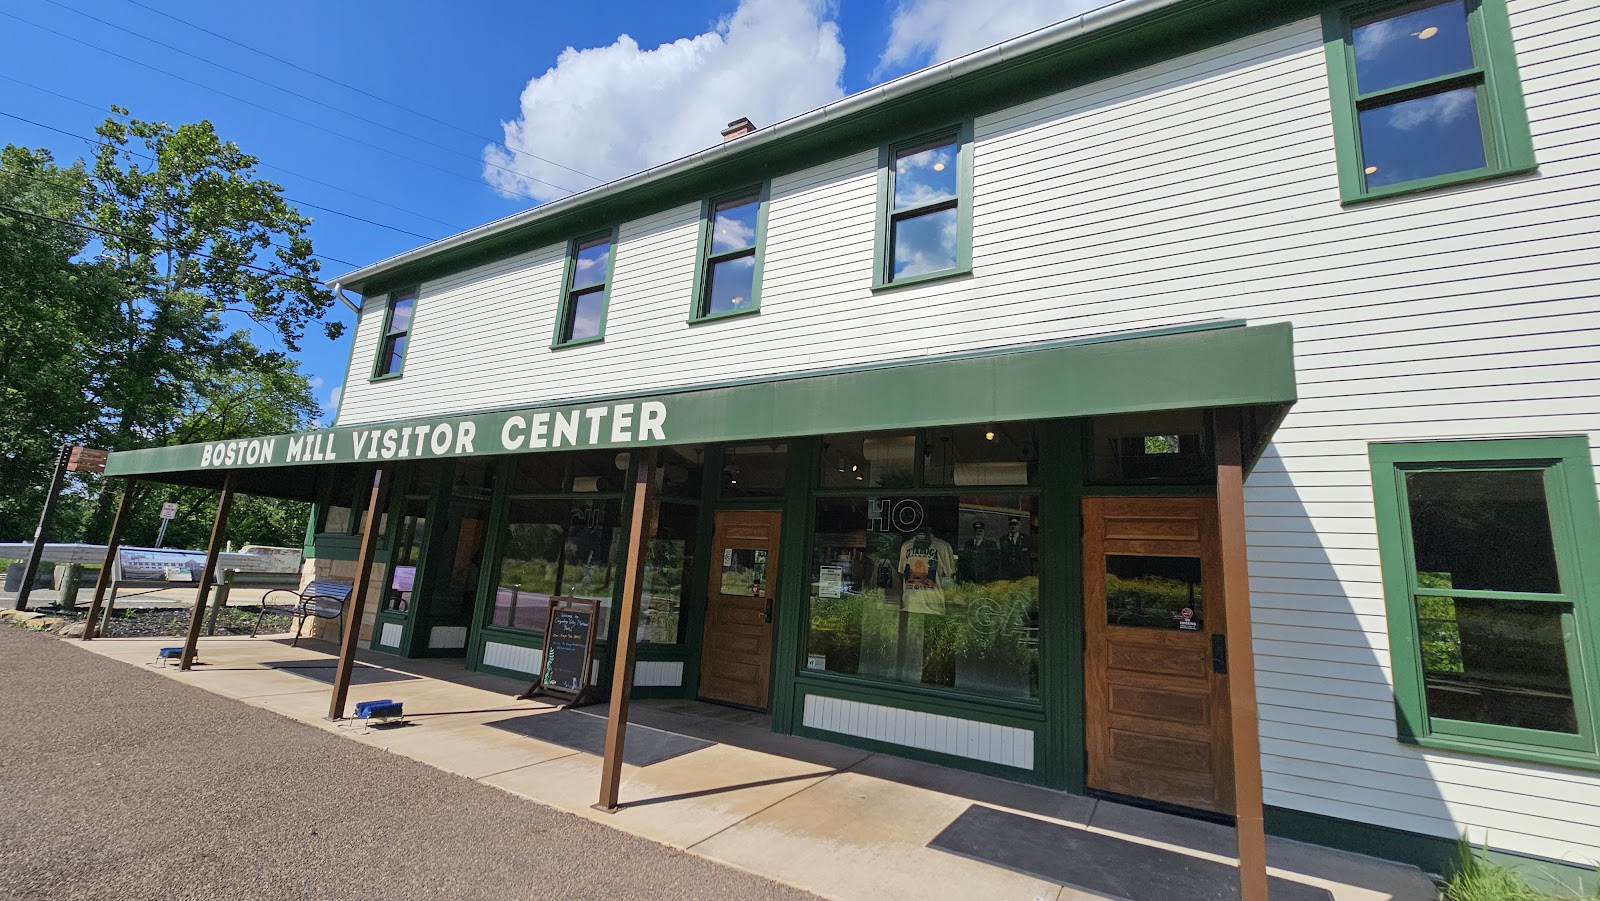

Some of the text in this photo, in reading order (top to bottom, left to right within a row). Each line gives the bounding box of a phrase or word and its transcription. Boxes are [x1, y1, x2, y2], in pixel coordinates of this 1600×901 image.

[200, 400, 668, 468] BOSTON MILL VISITOR CENTER
